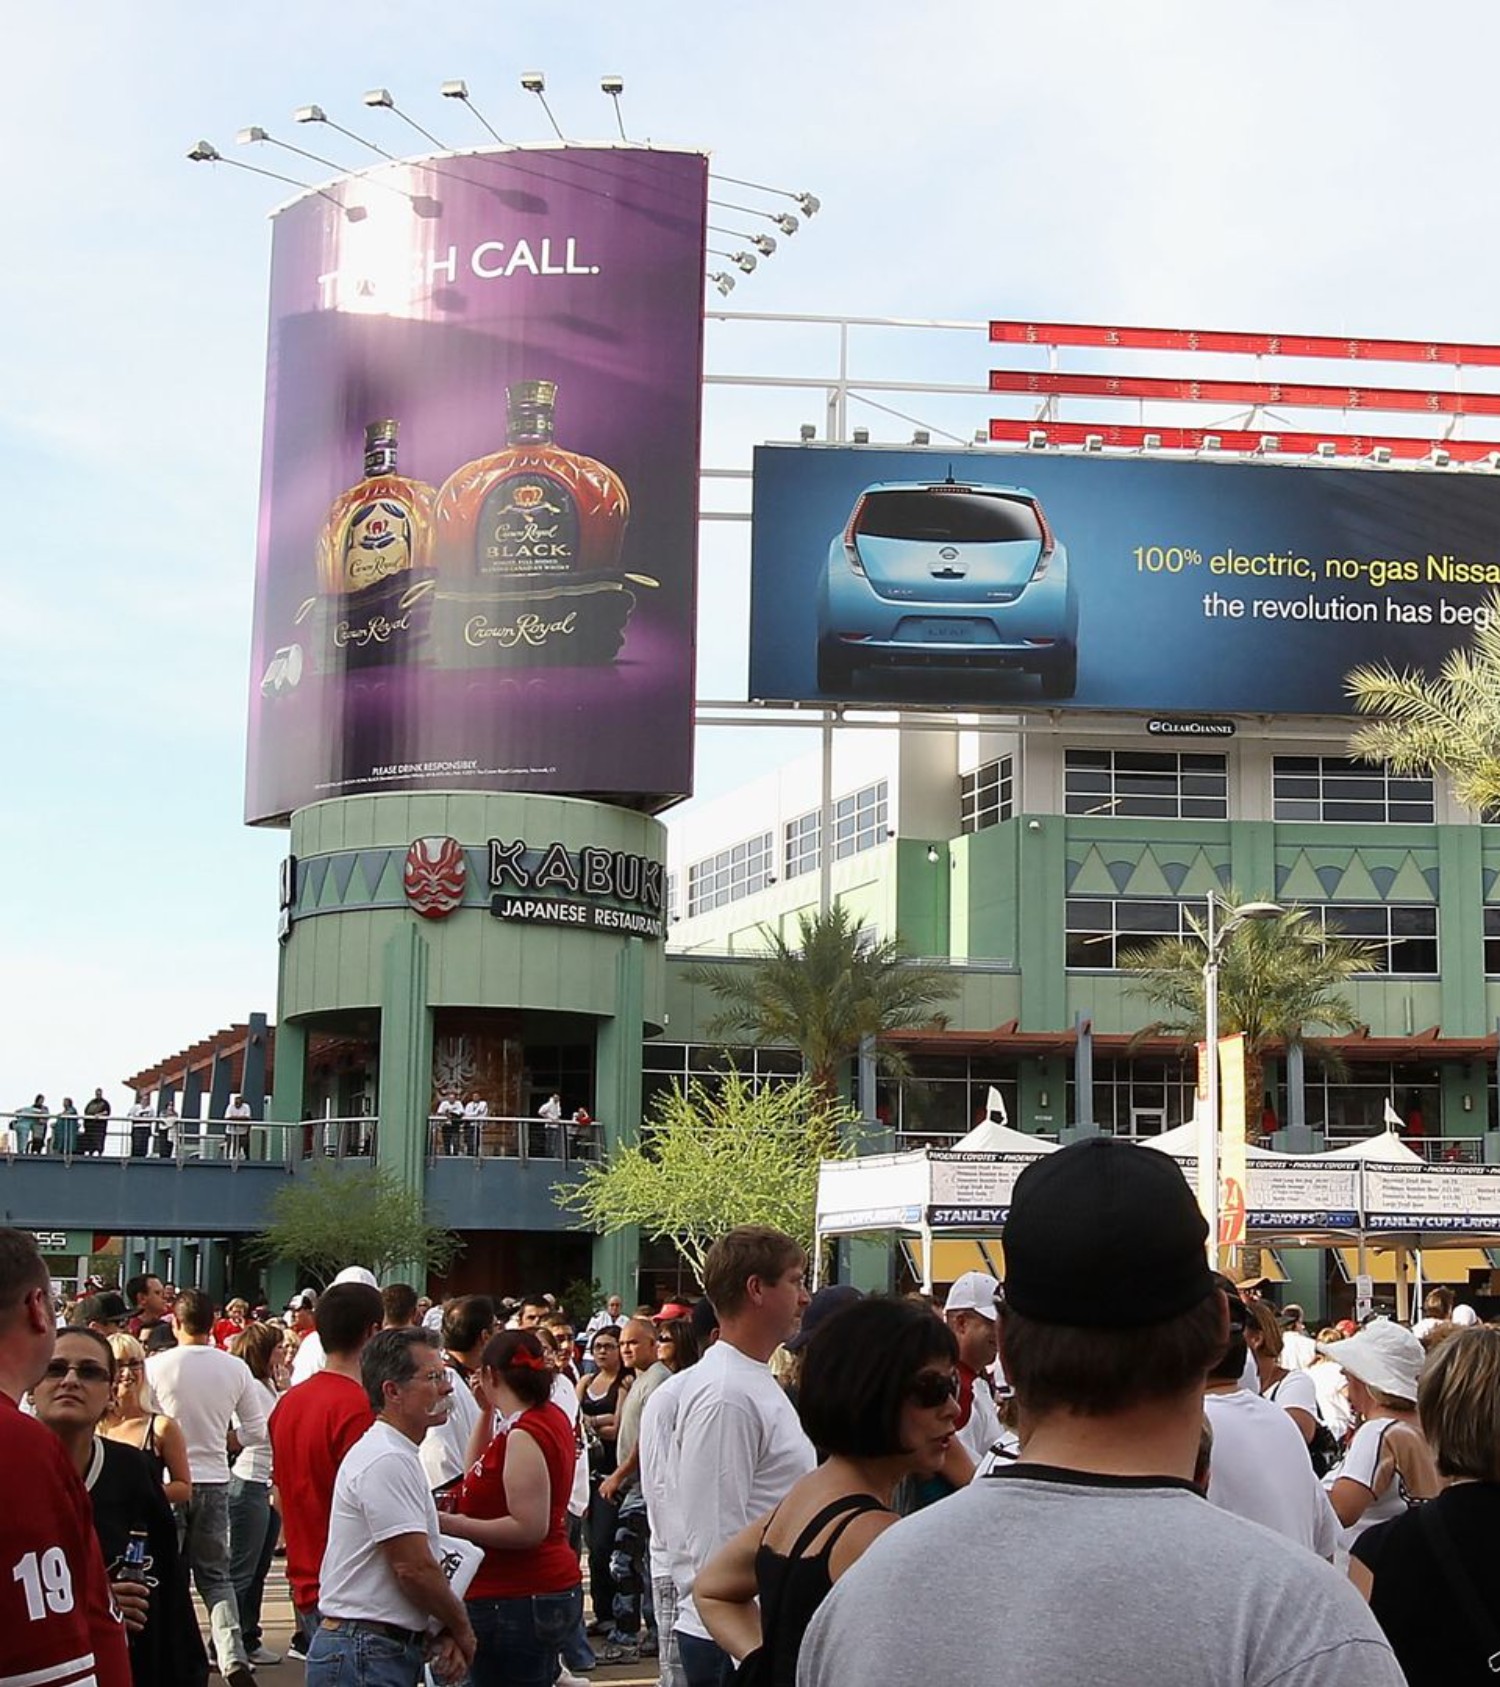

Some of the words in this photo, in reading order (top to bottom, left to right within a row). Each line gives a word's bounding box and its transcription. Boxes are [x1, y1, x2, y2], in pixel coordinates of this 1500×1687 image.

[471, 238, 600, 278] CALL.
[1133, 546, 1203, 573] 100%
[1209, 549, 1318, 582] electric,
[1326, 560, 1419, 587] no-gas
[1203, 593, 1245, 618] the
[1253, 595, 1376, 621] revolution
[1384, 598, 1433, 623] has
[334, 620, 369, 648] Crown
[356, 609, 411, 647] Royal
[465, 615, 515, 648] Crown
[499, 611, 578, 648] Royal
[501, 899, 587, 923] JAPANESE
[594, 908, 663, 937] RESTAURANT
[929, 1152, 962, 1161] PHOENIX
[962, 1153, 997, 1162] COYOTES
[1002, 1154, 1038, 1162] PHOENIX
[1293, 1161, 1324, 1169] PHOENIX
[1324, 1161, 1356, 1170] COYOTES
[1366, 1163, 1393, 1172] PHOENIX
[1394, 1164, 1423, 1173] COYOTES
[1427, 1166, 1456, 1174] PHOENIX
[1456, 1166, 1485, 1175] COYOTES
[934, 1209, 1001, 1222] STANLEY
[1252, 1212, 1316, 1225] PLAYOFFS
[1369, 1215, 1426, 1228] STANLEY
[1428, 1216, 1452, 1228] CUP
[12, 1546, 75, 1622] 19
